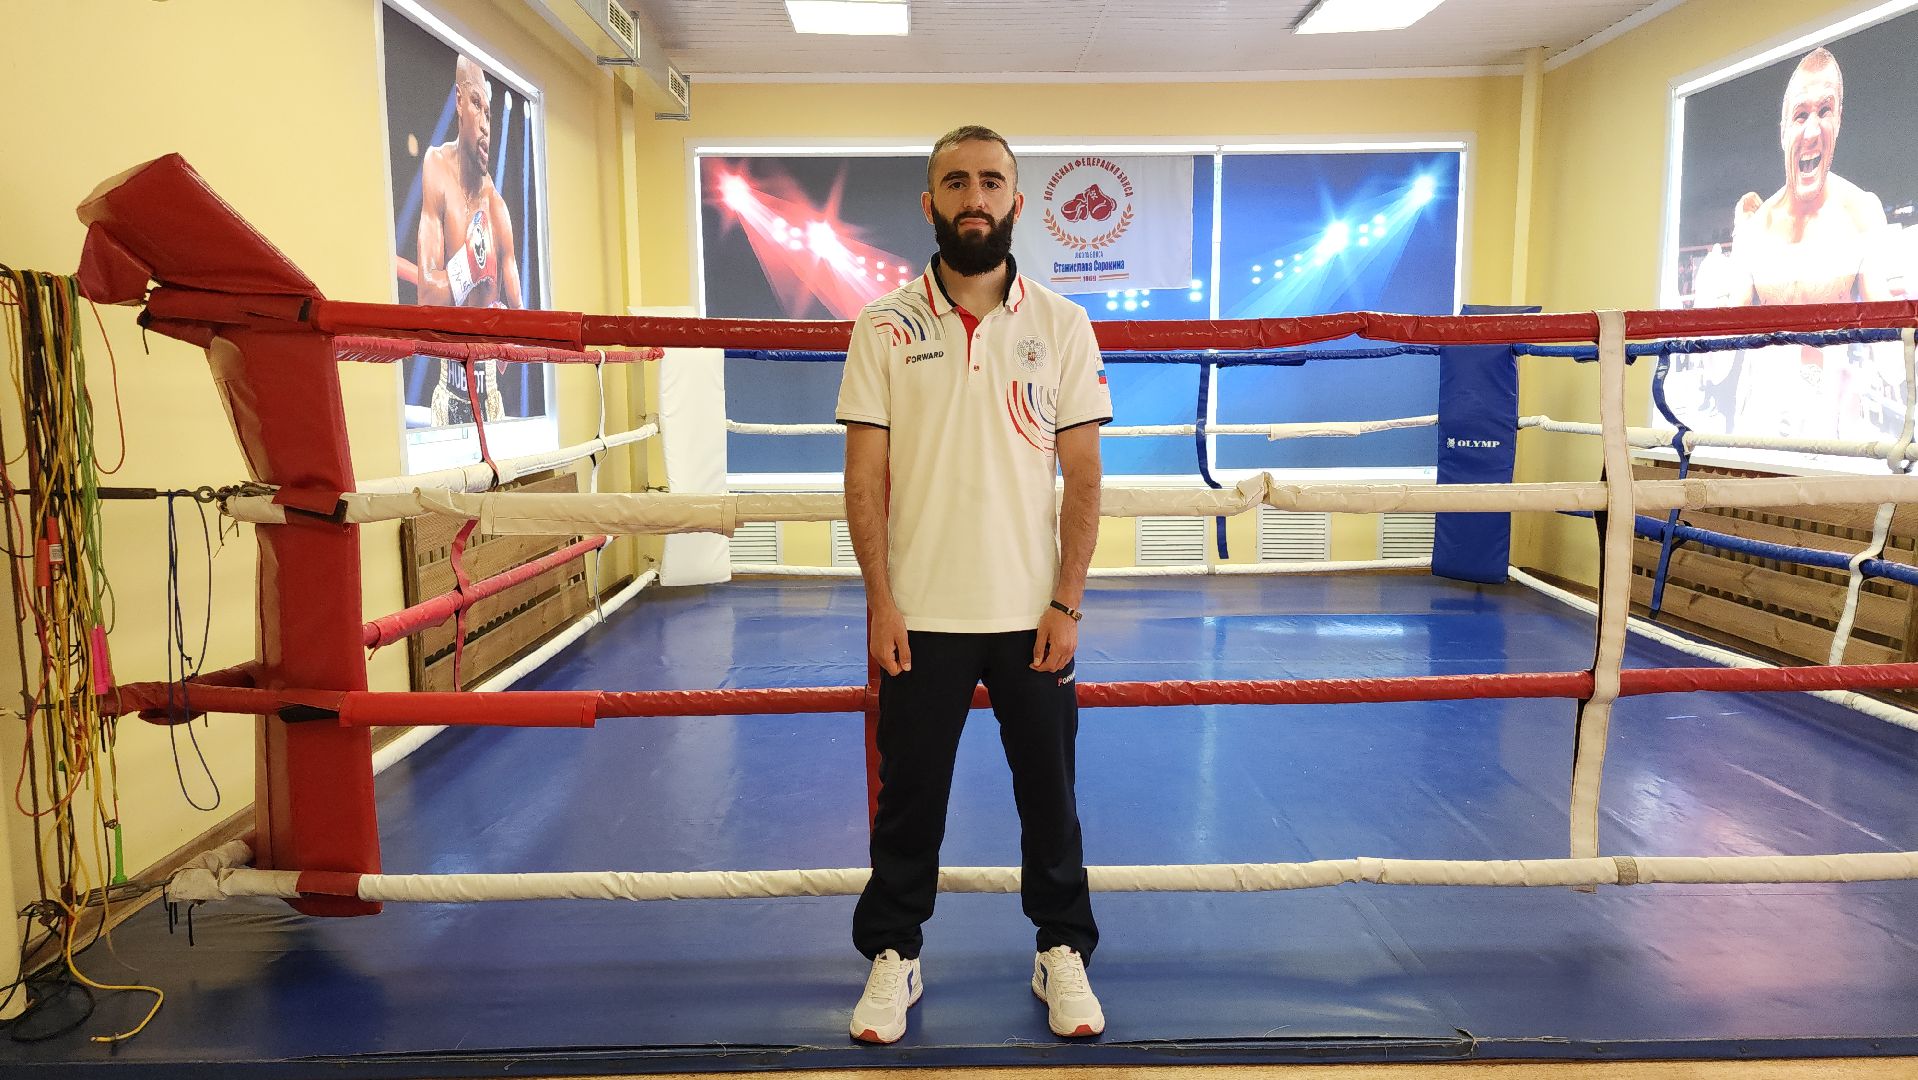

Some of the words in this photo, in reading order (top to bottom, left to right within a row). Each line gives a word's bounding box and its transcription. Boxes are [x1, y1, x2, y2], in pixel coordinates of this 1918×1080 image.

[1074, 157, 1120, 176] ФЕДЕРАЦИЯ
[1116, 172, 1134, 197] БОКСА
[906, 351, 944, 364] FORWARD
[1457, 440, 1500, 448] OLYMP
